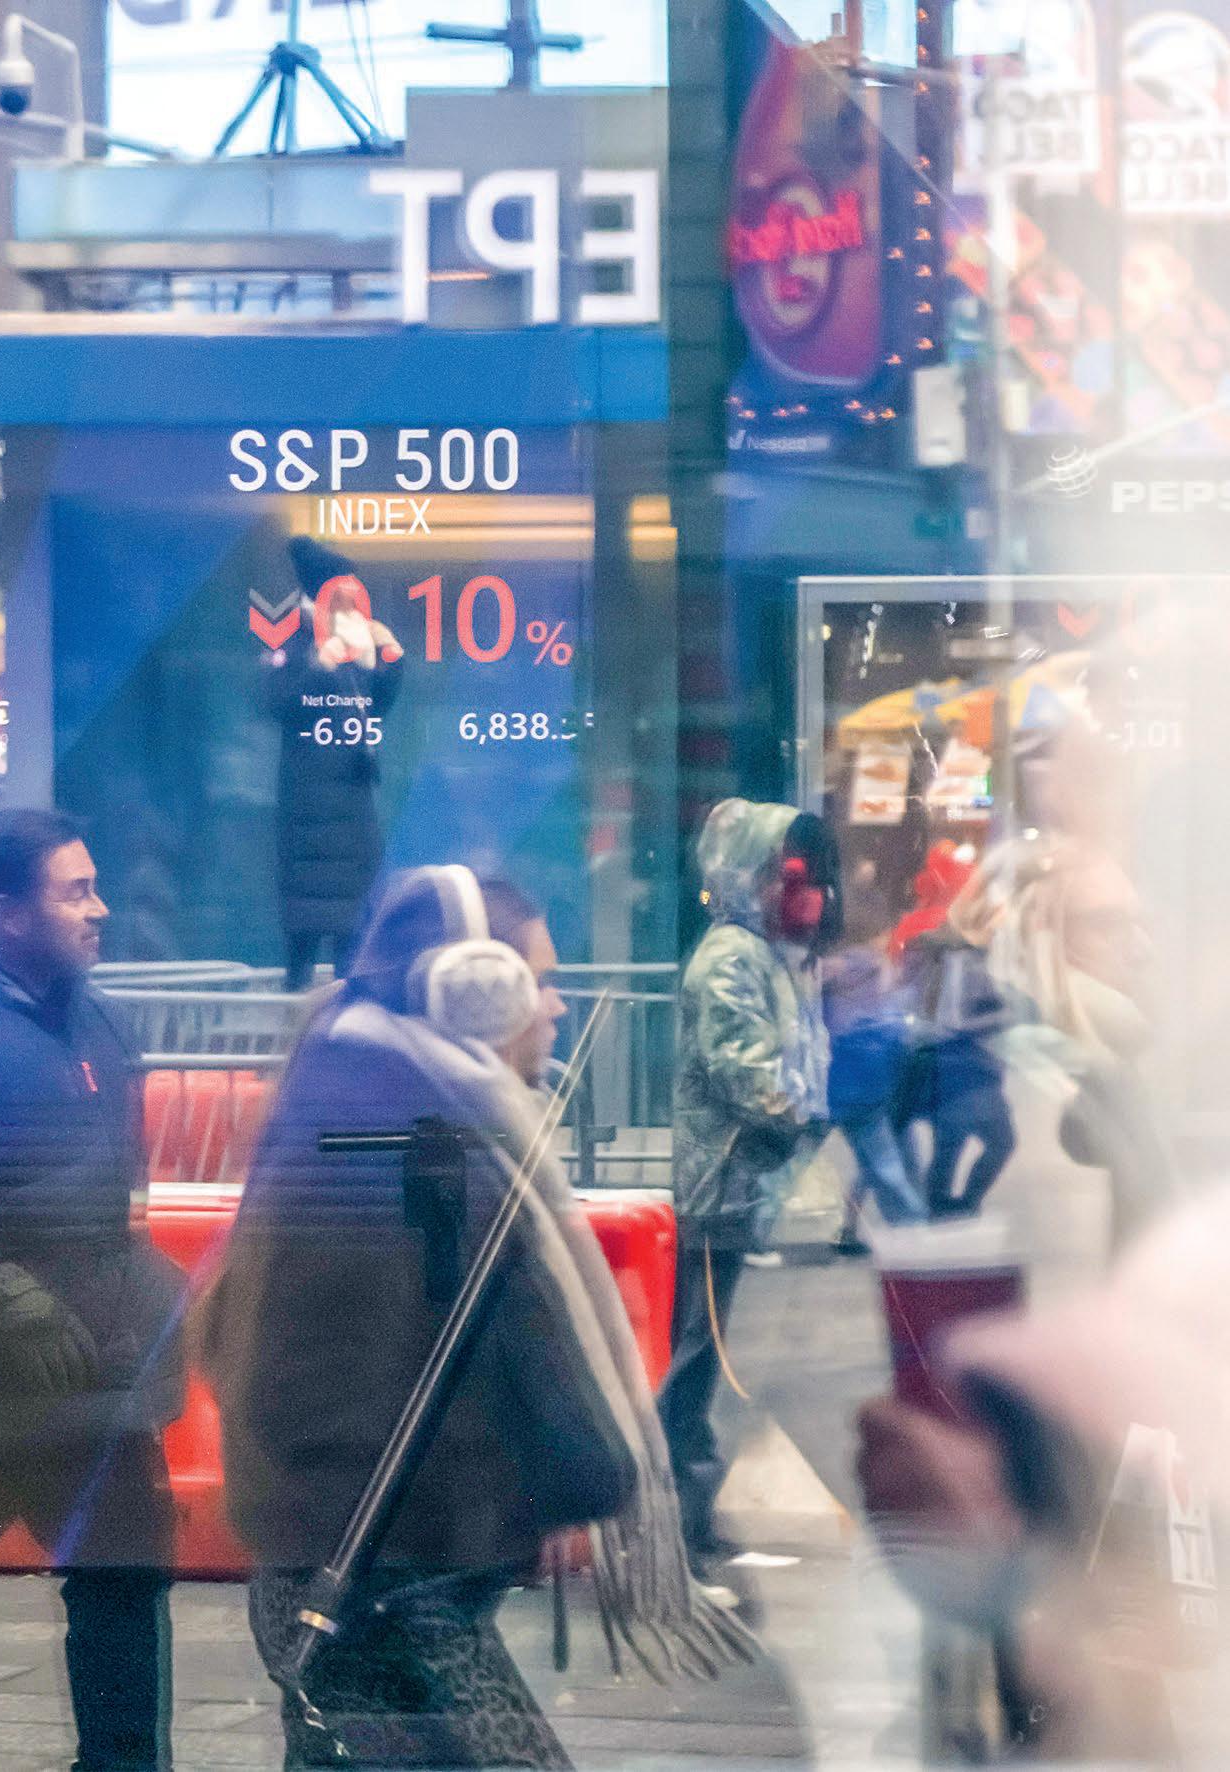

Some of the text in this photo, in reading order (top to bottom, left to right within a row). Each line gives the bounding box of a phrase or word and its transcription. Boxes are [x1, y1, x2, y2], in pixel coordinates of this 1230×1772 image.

[228, 428, 519, 492] S&P 500
[318, 498, 432, 535] INDEX
[302, 694, 373, 709] Net Change
[299, 717, 383, 746] -6.95
[458, 711, 595, 747] 6,838.
